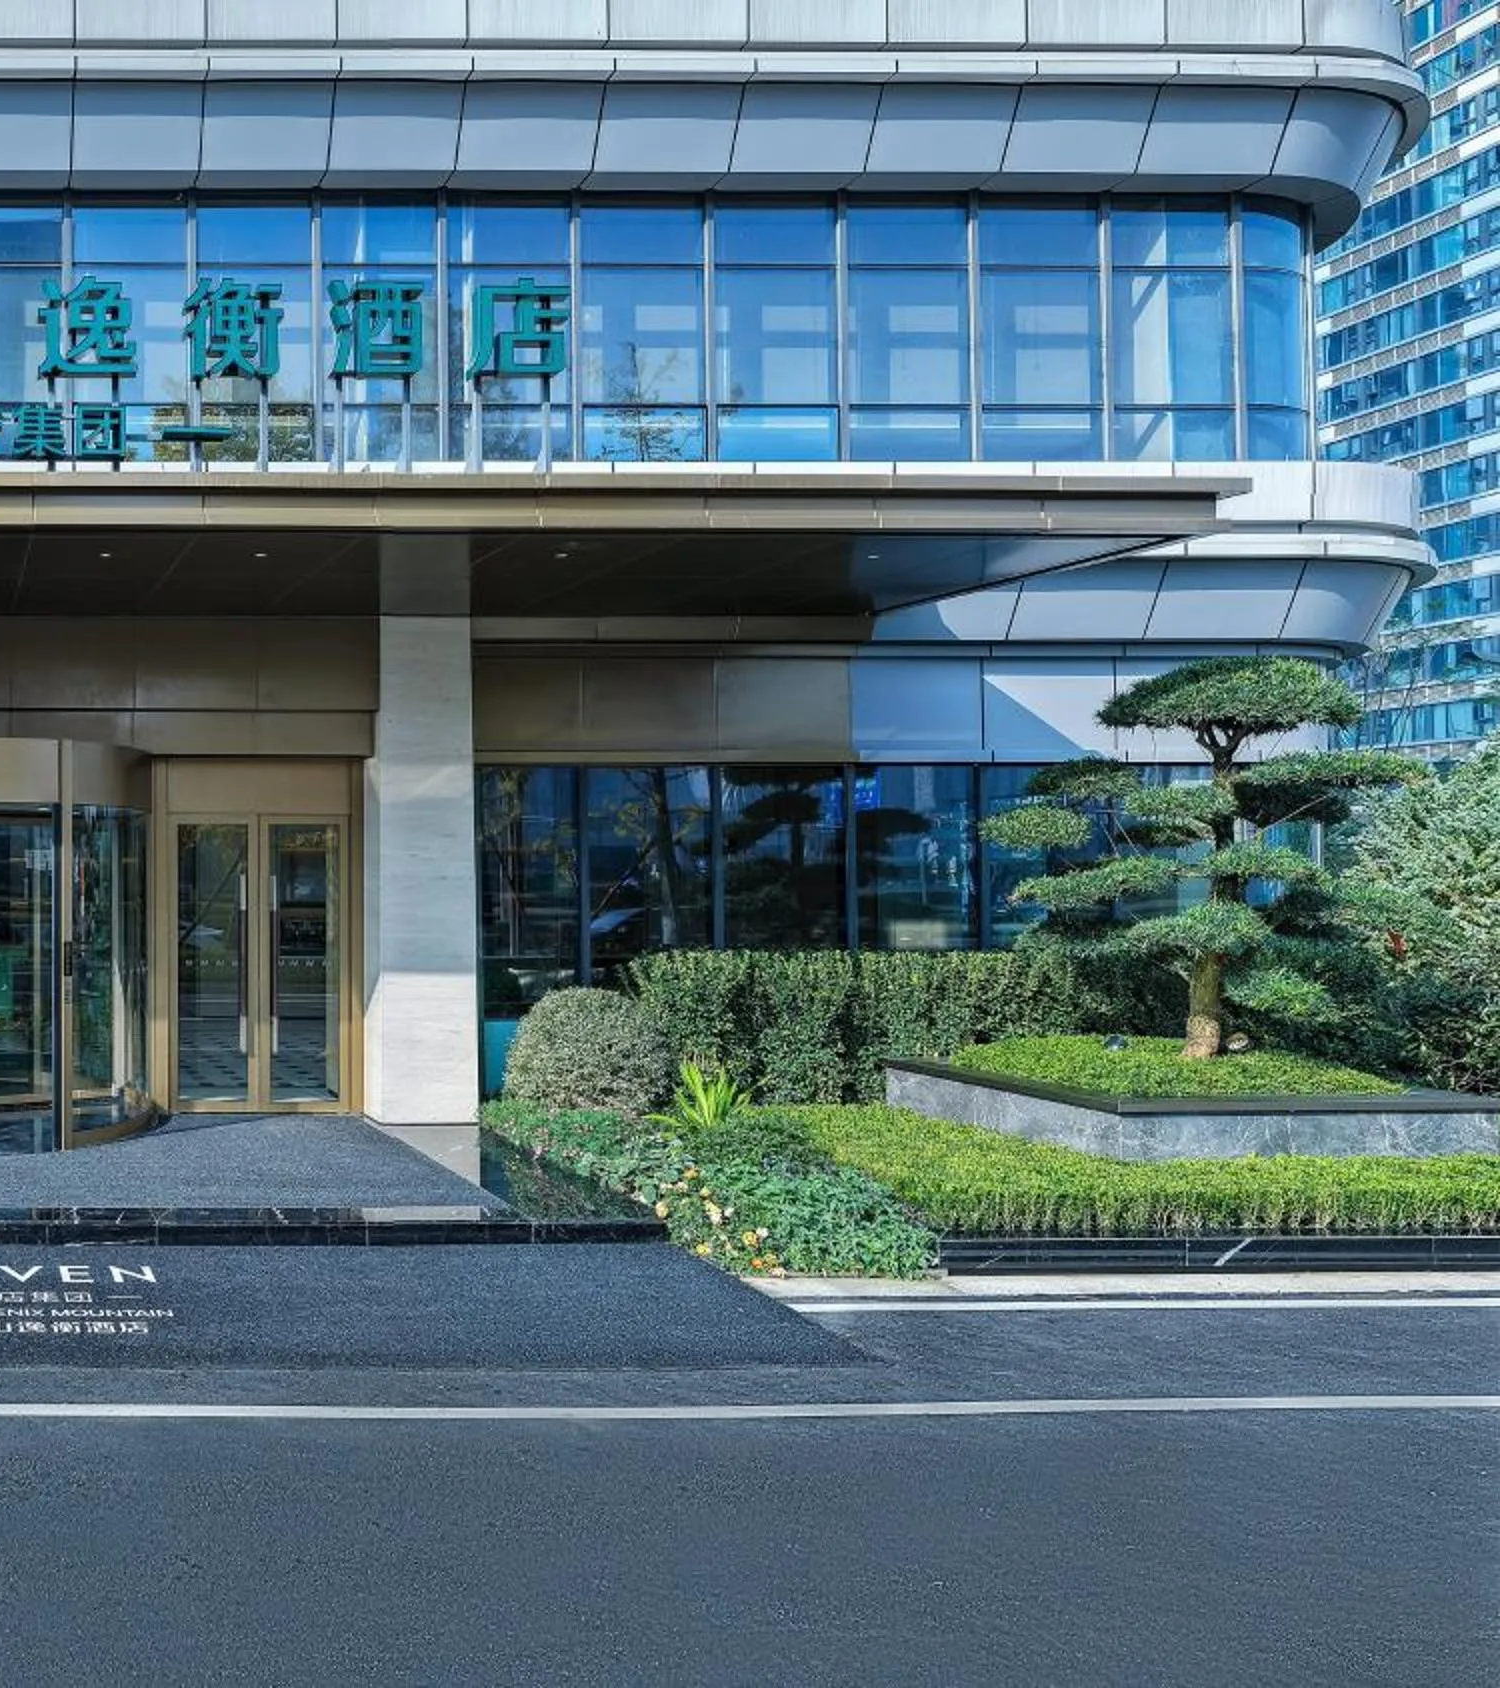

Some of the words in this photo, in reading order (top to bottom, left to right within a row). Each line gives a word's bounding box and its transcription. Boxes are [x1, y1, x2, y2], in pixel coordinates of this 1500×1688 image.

[37, 276, 571, 381] 逸衡酒店
[51, 1308, 174, 1318] MOUNTAIN
